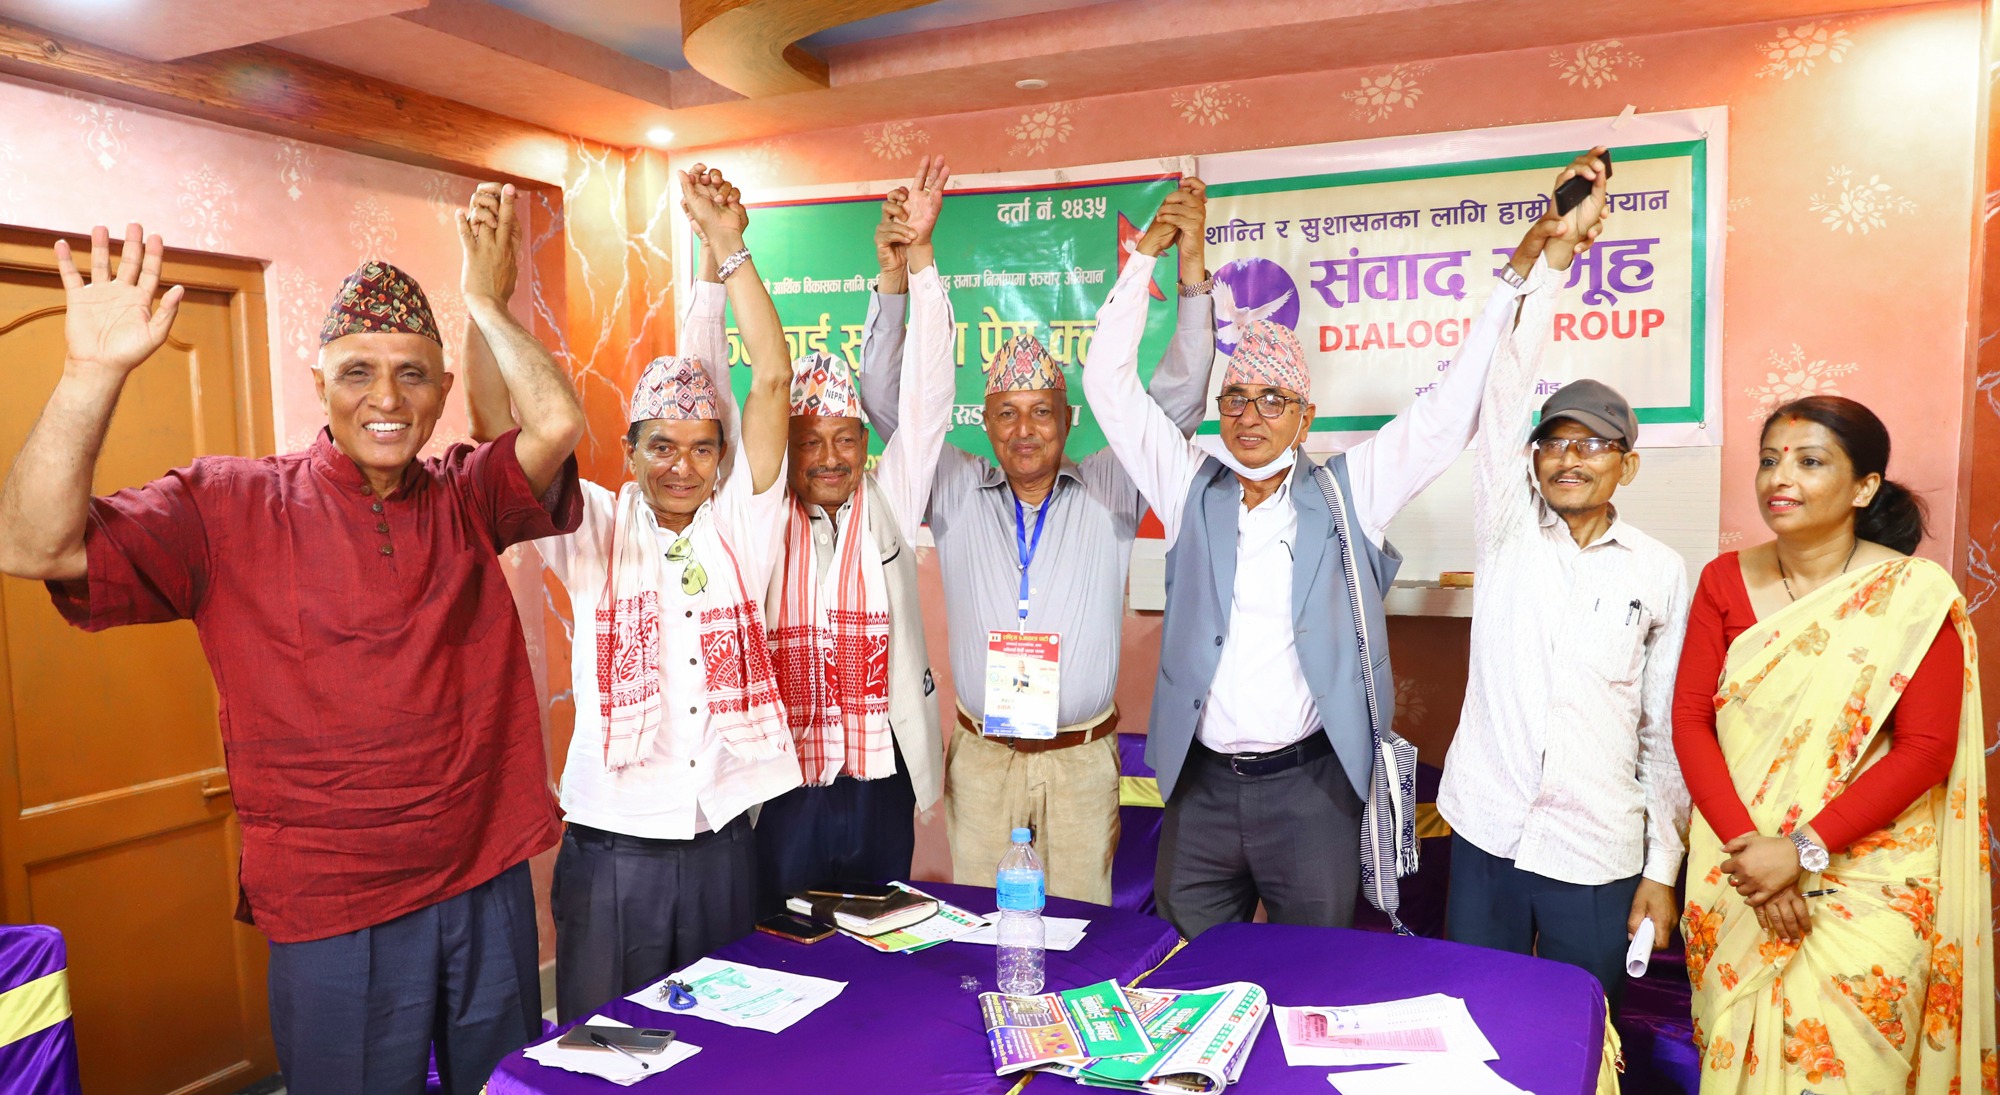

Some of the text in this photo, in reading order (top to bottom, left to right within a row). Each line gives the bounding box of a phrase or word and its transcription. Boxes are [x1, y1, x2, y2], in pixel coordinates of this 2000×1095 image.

[997, 197, 1031, 224] दर्ता
[1062, 197, 1107, 219] २४३५
[1205, 218, 1265, 245] शान्ति
[1275, 220, 1290, 239] र
[1299, 209, 1420, 243] सुशासनका
[1430, 199, 1487, 227] लागि
[803, 275, 841, 294] विकासका
[844, 274, 864, 293] लागि
[953, 274, 980, 289] समाज
[1310, 247, 1471, 308] संवाद
[1319, 309, 1665, 353] DIALOG ROUP
